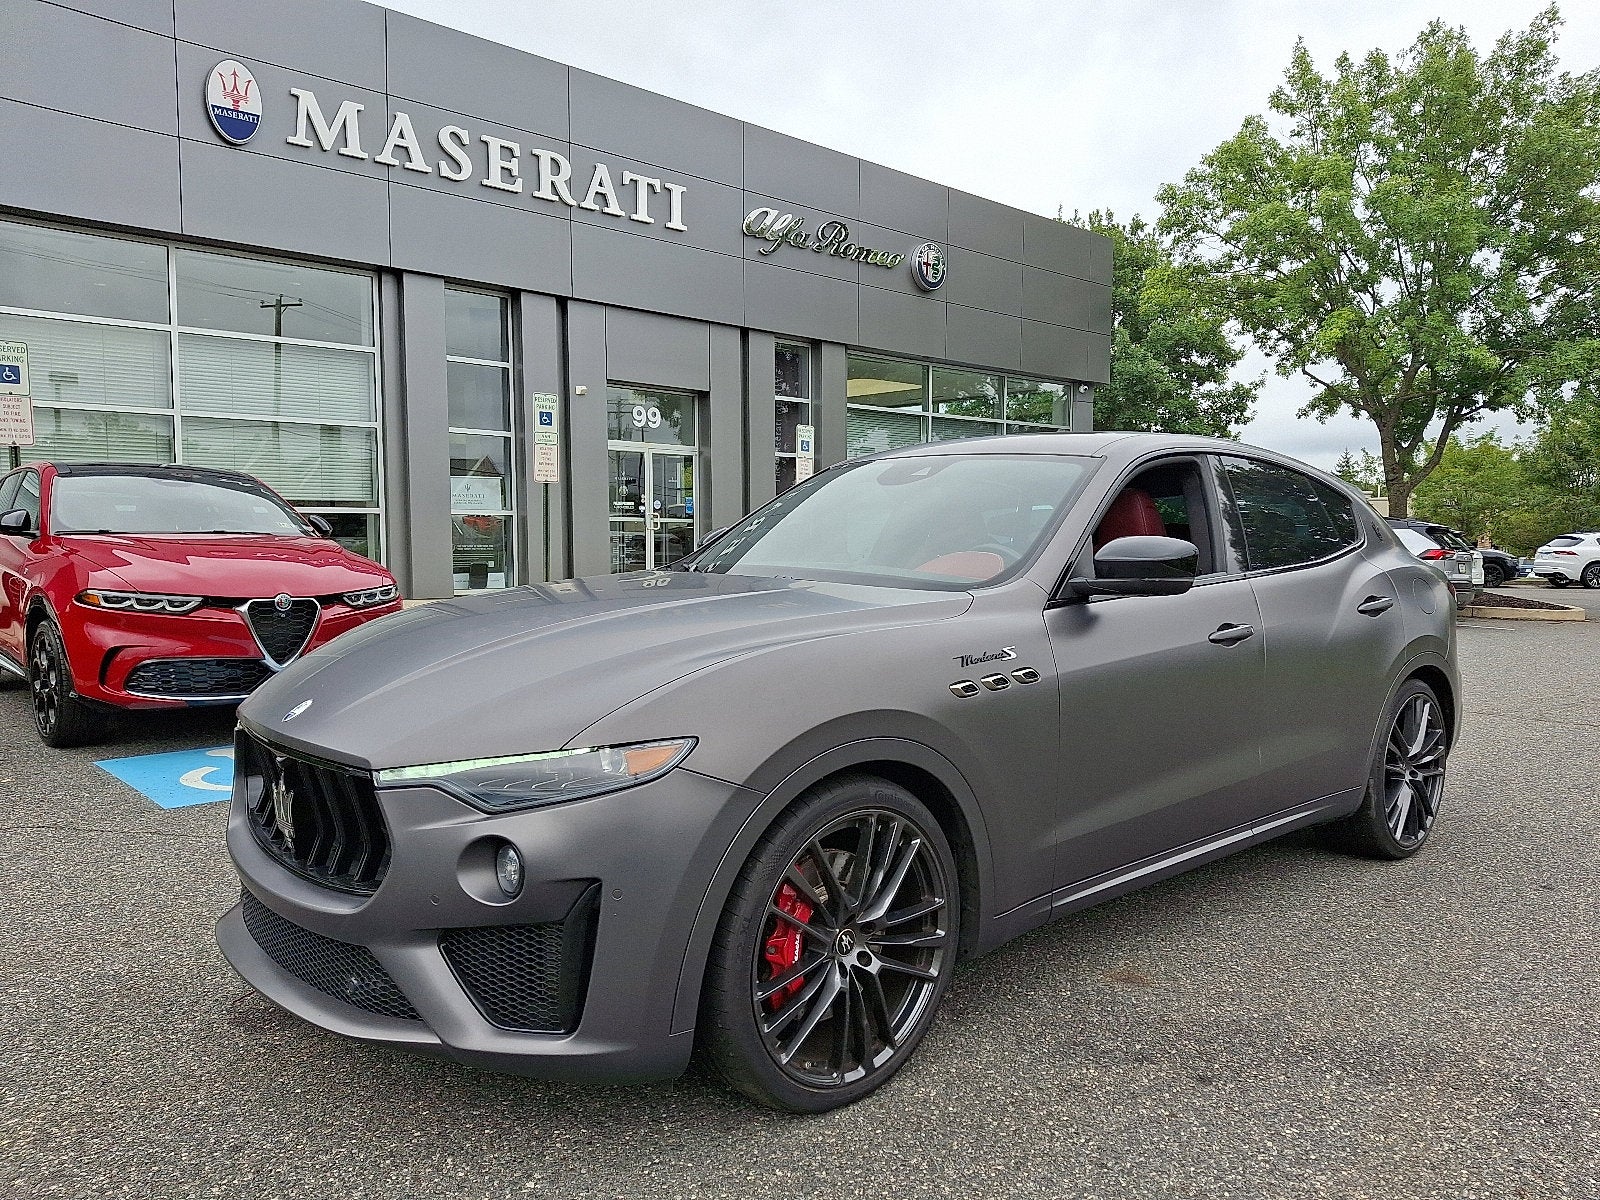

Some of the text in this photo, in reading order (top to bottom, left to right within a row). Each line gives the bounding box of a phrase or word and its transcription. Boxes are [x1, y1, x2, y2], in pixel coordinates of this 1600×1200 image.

[213, 107, 258, 123] MASERATI
[286, 88, 688, 231] MASERATI
[742, 207, 905, 268] Alfa Romeo
[0, 355, 24, 363] RKING
[632, 405, 661, 428] 99
